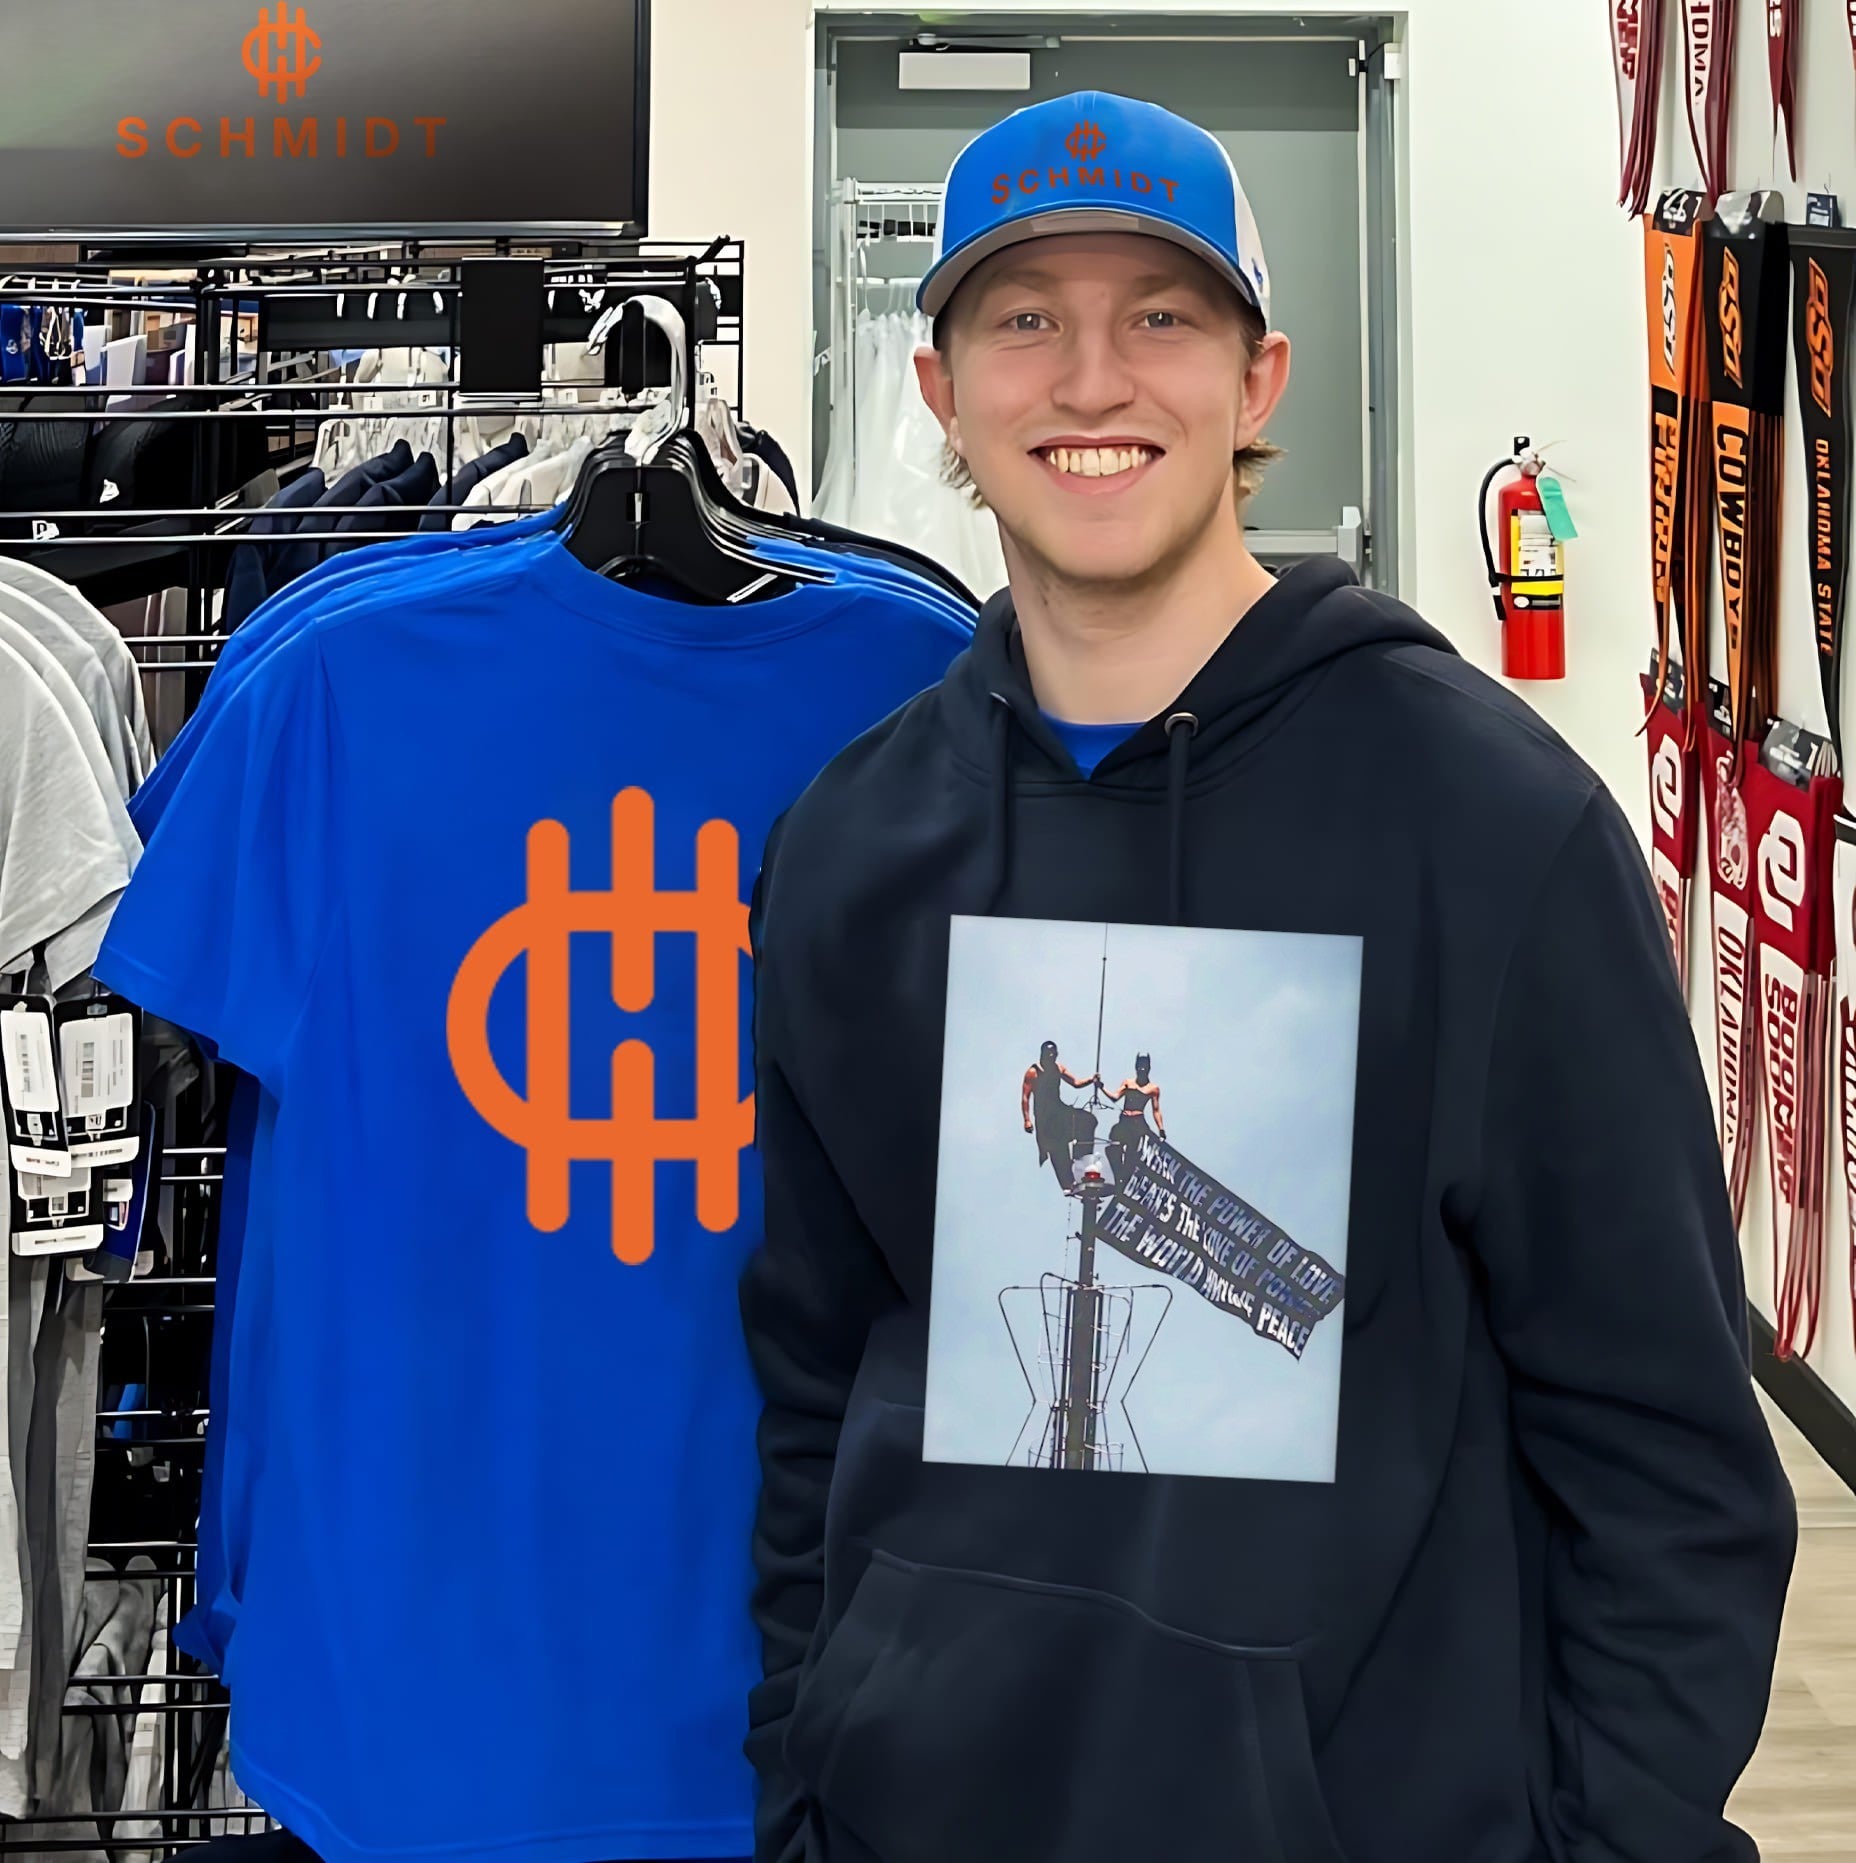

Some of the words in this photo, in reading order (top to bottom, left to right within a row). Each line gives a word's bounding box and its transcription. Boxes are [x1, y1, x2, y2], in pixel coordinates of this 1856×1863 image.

[115, 116, 448, 159] SCHMIDT
[991, 166, 1180, 205] SCHMIDT
[1815, 439, 1832, 570] OKLAHOMA
[1718, 926, 1744, 1144] OKLAHOMA
[1103, 1201, 1144, 1243] THE
[1256, 1301, 1311, 1357] PEACE
[1178, 1170, 1213, 1208] THE
[1206, 1193, 1271, 1249] POWER
[1266, 1238, 1299, 1269] OF
[1290, 1255, 1339, 1305] LOVE
[1231, 1249, 1260, 1280] OF
